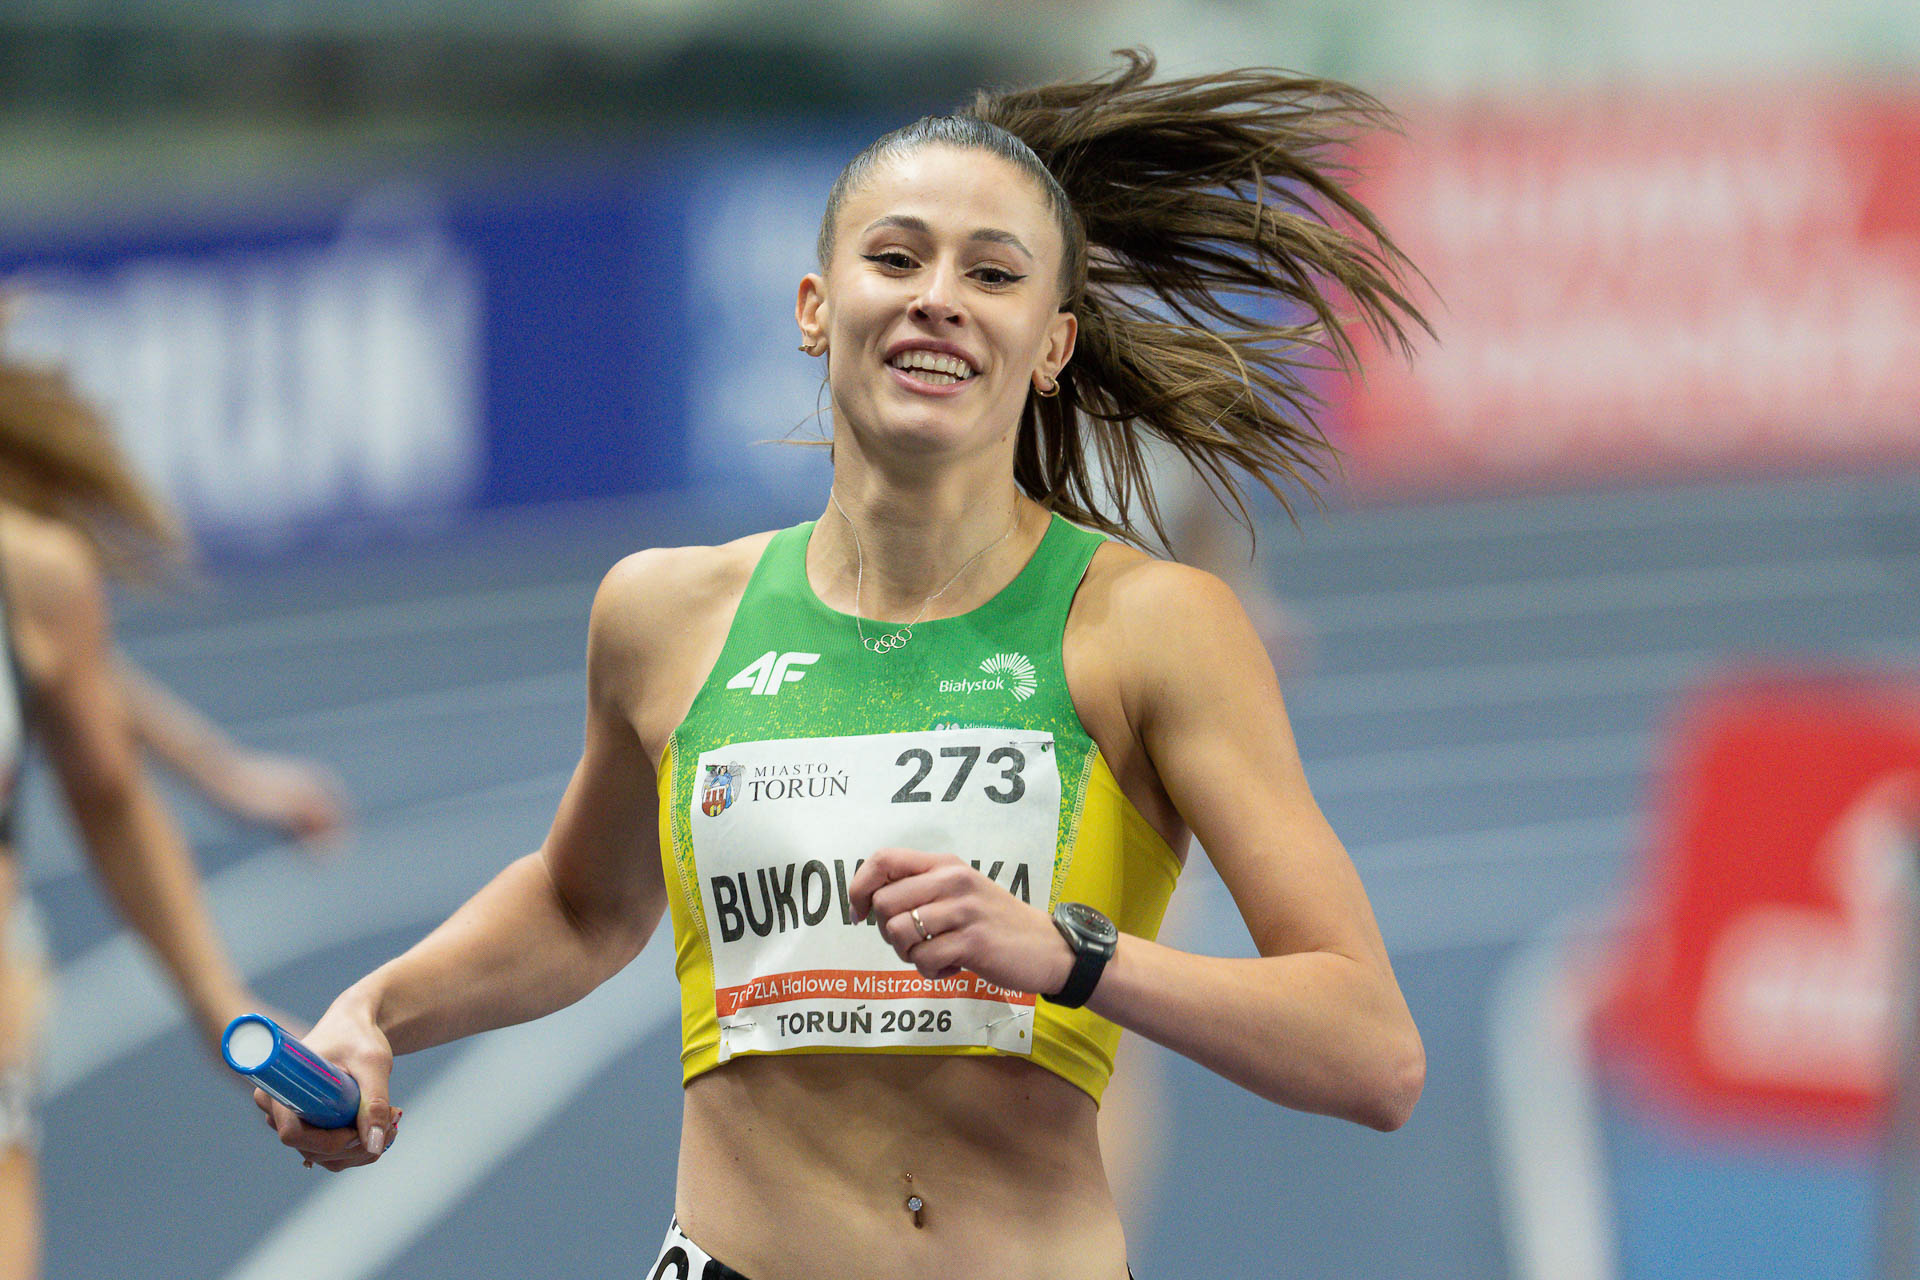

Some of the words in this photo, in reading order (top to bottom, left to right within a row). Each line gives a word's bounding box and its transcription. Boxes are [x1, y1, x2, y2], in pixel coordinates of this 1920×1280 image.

[727, 651, 820, 696] 4F
[939, 677, 1005, 696] Białystok
[754, 763, 829, 778] MIASTO
[891, 746, 1026, 804] 273
[748, 771, 849, 802] TORUŃ
[746, 981, 779, 1001] PZLA
[782, 976, 847, 995] Halowe
[854, 975, 969, 993] Mistrzostwa
[777, 1004, 872, 1037] TORUŃ
[880, 1009, 952, 1033] 2026
